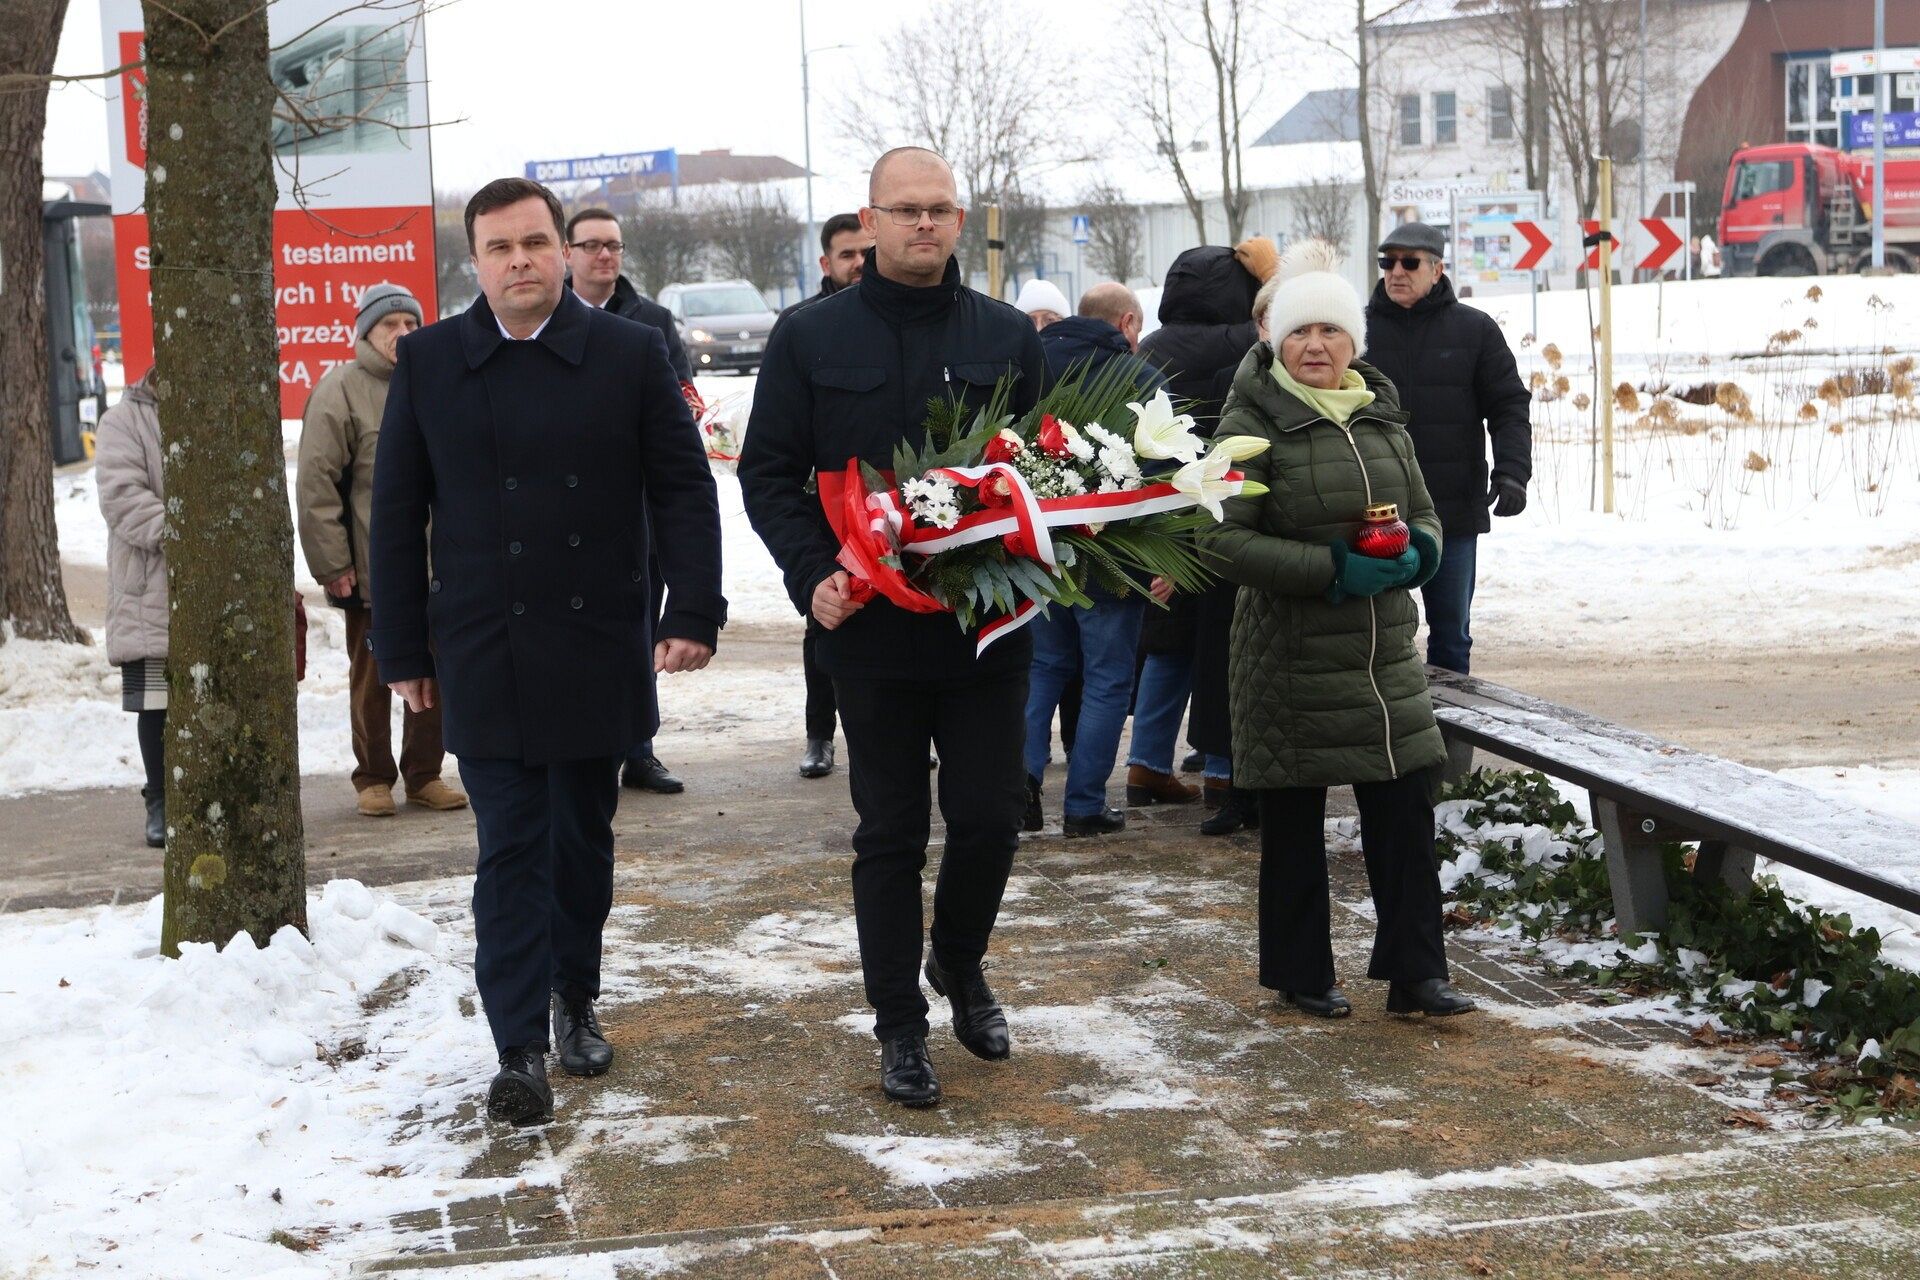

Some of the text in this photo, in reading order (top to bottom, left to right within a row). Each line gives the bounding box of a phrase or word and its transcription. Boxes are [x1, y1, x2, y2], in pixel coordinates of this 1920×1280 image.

[536, 153, 655, 181] DOM HANDLOWY
[282, 240, 416, 265] testament
[325, 280, 332, 303] i
